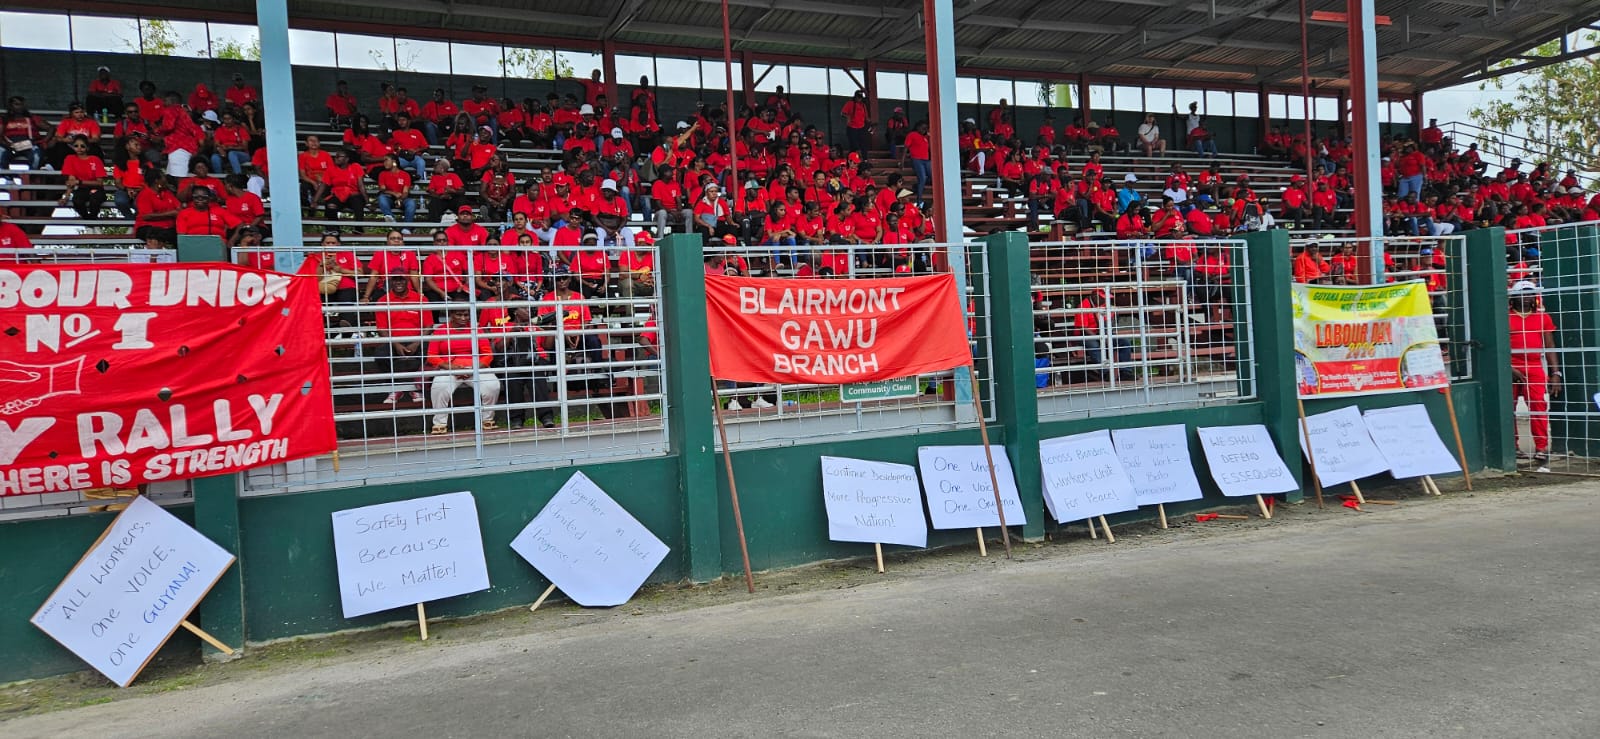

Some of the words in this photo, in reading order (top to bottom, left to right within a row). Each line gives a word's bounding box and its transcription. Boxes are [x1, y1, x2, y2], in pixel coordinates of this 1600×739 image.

[739, 286, 906, 315] BLAIRMONT
[111, 312, 158, 350] 1
[779, 318, 878, 350] GAWU
[1315, 321, 1368, 348] LABOUR
[1371, 320, 1393, 345] DAY
[773, 353, 879, 376] BRANCH
[848, 384, 891, 395] Community
[892, 383, 912, 392] Clean
[76, 393, 284, 459] RALLY
[1209, 436, 1225, 446] WE
[1227, 434, 1257, 446] SHALL
[102, 460, 132, 486] IS
[143, 437, 289, 480] STRENGTH
[934, 456, 960, 471] One
[1220, 452, 1260, 463] DEFEND
[856, 488, 913, 507] Progressive
[939, 479, 963, 494] One
[355, 512, 407, 535] Safety
[416, 502, 452, 526] First
[944, 499, 971, 514] One
[358, 536, 450, 564] Because
[143, 561, 201, 624] GUYANA!
[356, 579, 387, 597] We
[401, 561, 457, 585] Matter!
